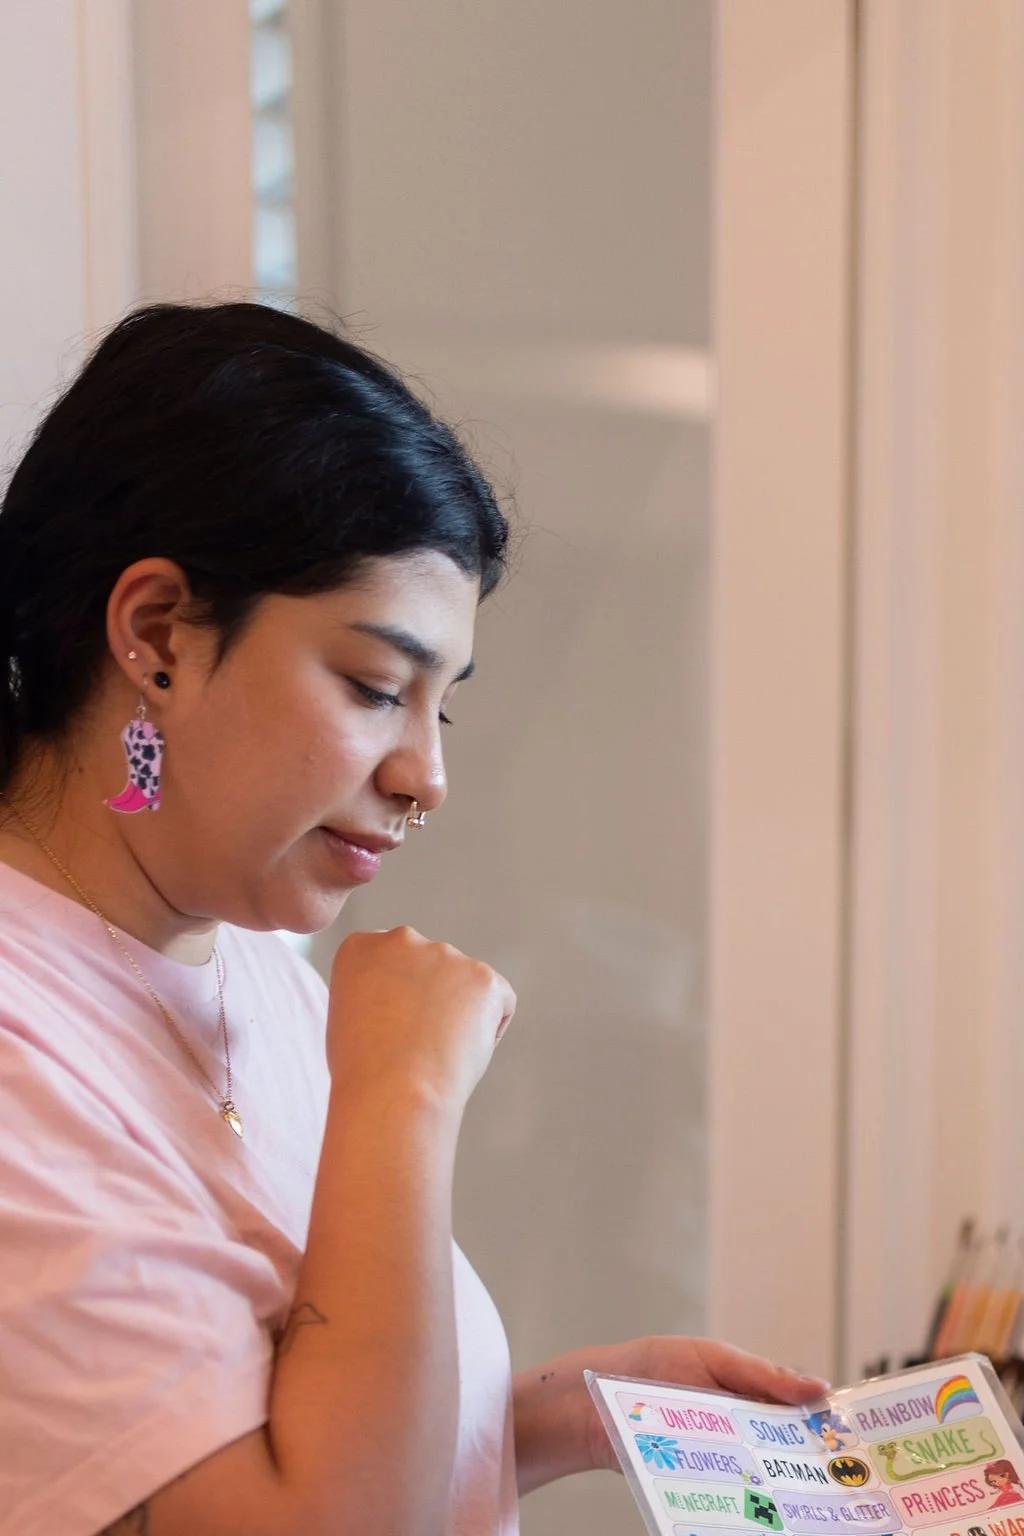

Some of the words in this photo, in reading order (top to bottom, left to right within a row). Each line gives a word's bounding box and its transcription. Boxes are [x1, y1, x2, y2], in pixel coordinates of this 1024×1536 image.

[660, 1406, 735, 1435] UNICORN
[856, 1395, 936, 1432] RAINBOW
[749, 1419, 805, 1446] SONIC
[902, 1428, 976, 1465] SNAKE
[674, 1449, 743, 1475] FLOWERS
[763, 1458, 829, 1485] BATMAN
[664, 1490, 740, 1514] MINECRAFT
[901, 1478, 987, 1517] PRINCESS
[782, 1503, 827, 1522] SWIRLS
[827, 1506, 839, 1522] &
[840, 1502, 890, 1523] GLITTER
